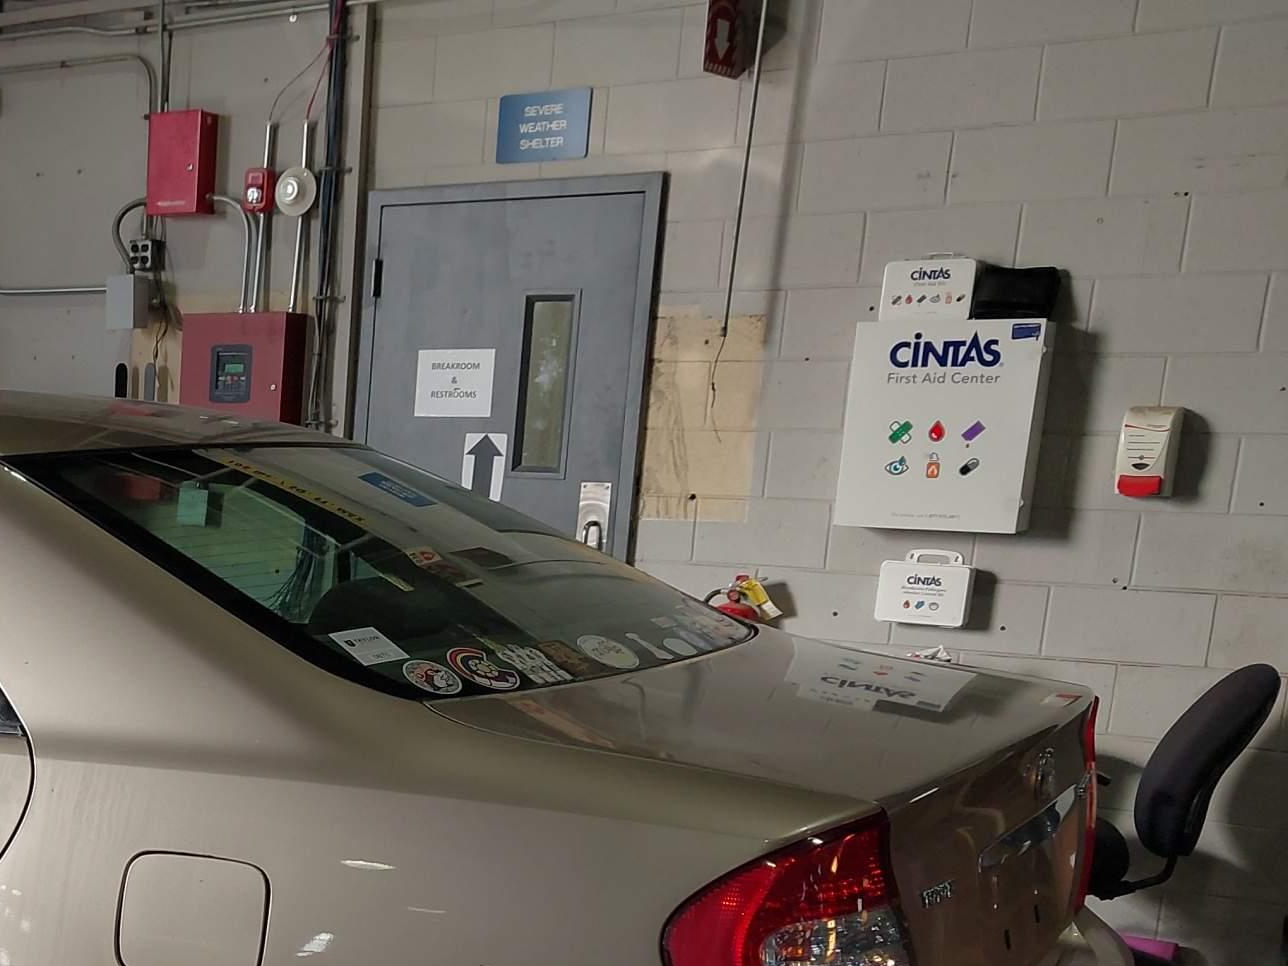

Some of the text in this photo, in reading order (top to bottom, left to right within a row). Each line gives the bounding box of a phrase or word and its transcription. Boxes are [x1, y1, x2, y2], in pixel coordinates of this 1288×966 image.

[524, 104, 564, 117] SEVERE
[519, 119, 567, 134] WEATHER
[520, 136, 564, 150] SHELTER
[431, 362, 481, 371] BREAKROOM
[451, 376, 458, 384] &
[887, 372, 1001, 384] First Aid Center
[430, 390, 478, 399] RESTROOMS
